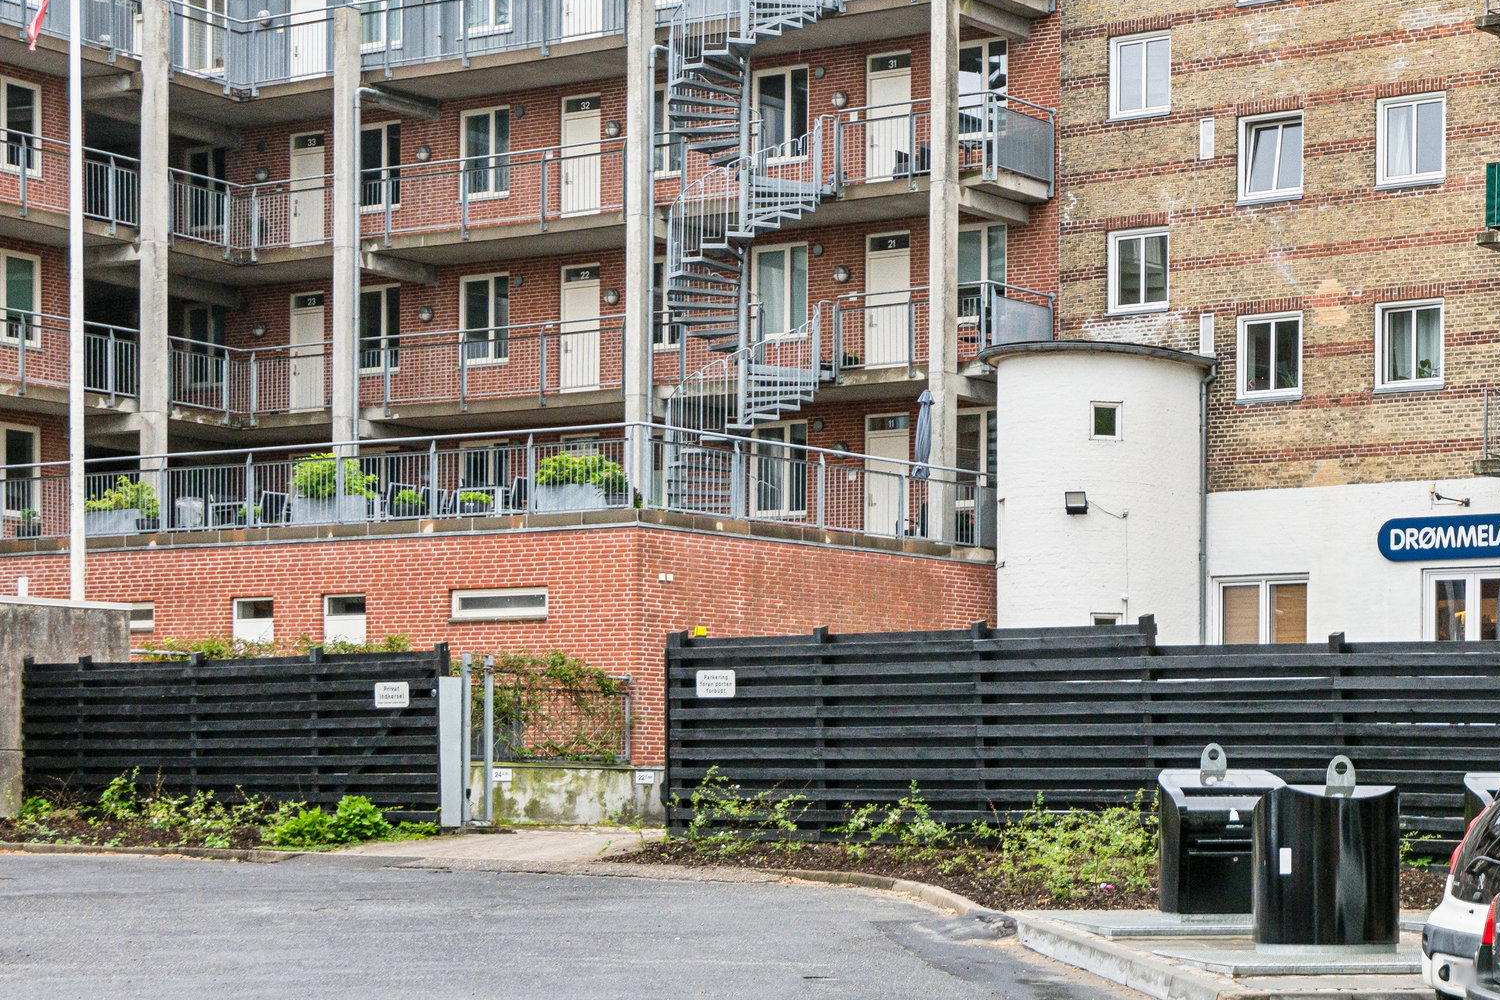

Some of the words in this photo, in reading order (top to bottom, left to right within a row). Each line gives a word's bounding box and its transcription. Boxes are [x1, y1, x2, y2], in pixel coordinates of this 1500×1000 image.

[888, 59, 897, 69] 31
[580, 101, 590, 110] 32
[307, 138, 317, 147] 33
[887, 239, 896, 249] 21
[580, 270, 590, 280] 22
[307, 297, 317, 306] 23
[888, 419, 895, 428] 11
